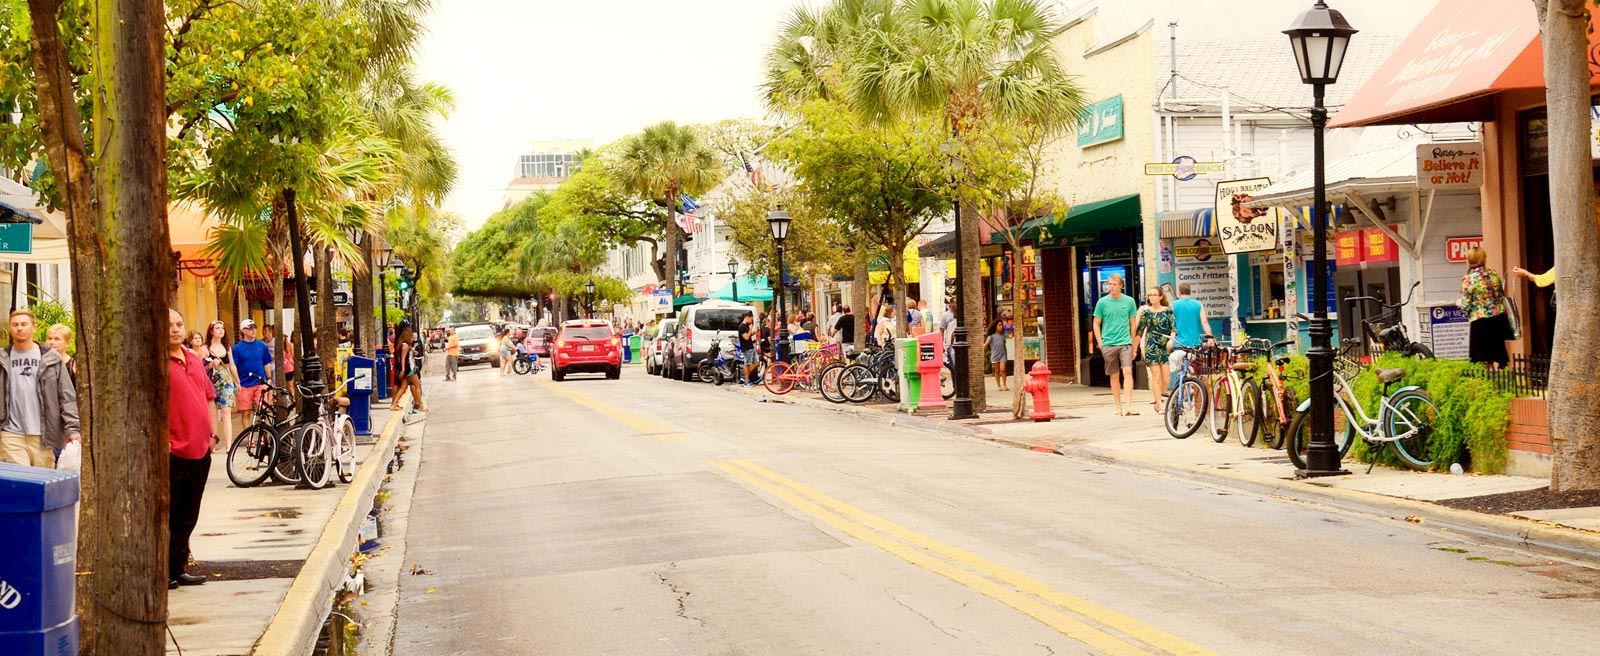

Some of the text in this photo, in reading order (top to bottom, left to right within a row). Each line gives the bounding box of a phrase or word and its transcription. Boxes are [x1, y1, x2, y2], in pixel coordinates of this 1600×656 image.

[1423, 158, 1479, 171] Believe It
[1431, 171, 1471, 184] or Not!
[1222, 223, 1275, 240] SALOON
